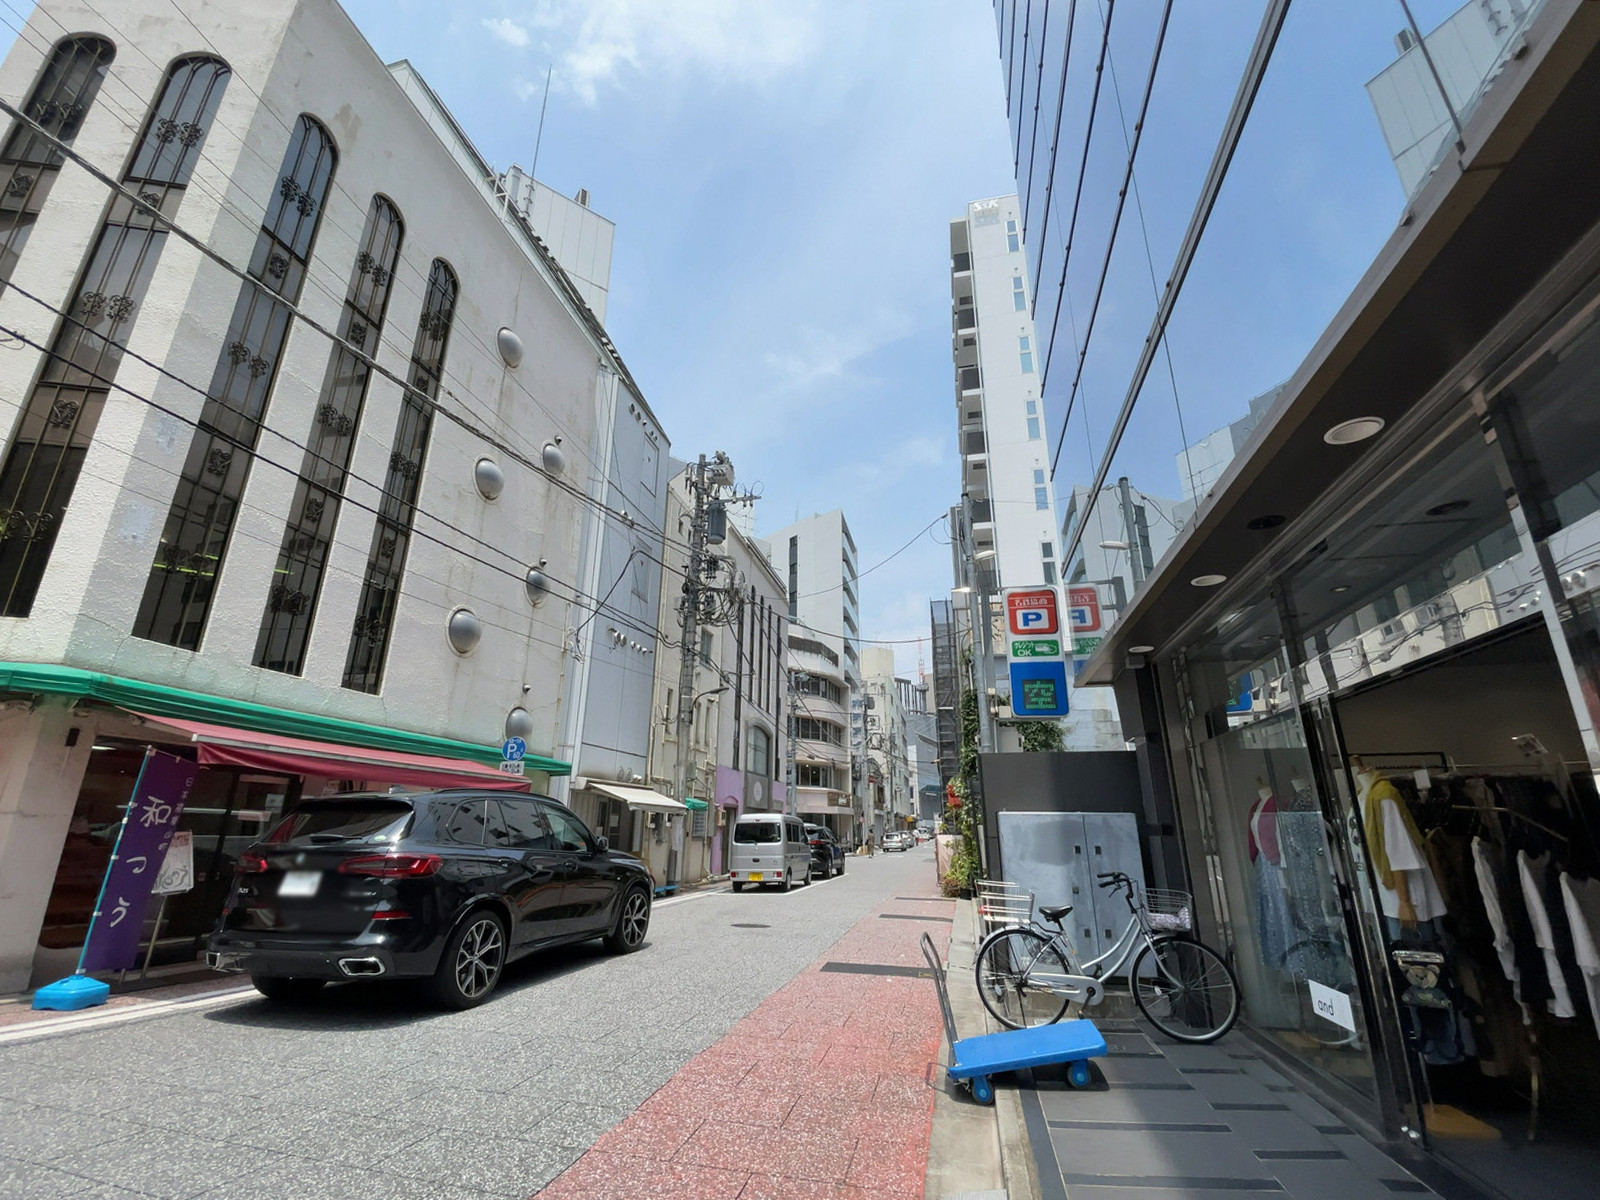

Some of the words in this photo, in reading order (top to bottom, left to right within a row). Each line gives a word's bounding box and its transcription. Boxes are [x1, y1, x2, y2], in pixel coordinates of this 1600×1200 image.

[1022, 612, 1043, 627] P
[1017, 649, 1032, 657] OK
[1024, 680, 1057, 709] 空
[507, 743, 517, 758] P
[1317, 998, 1335, 1017] and
